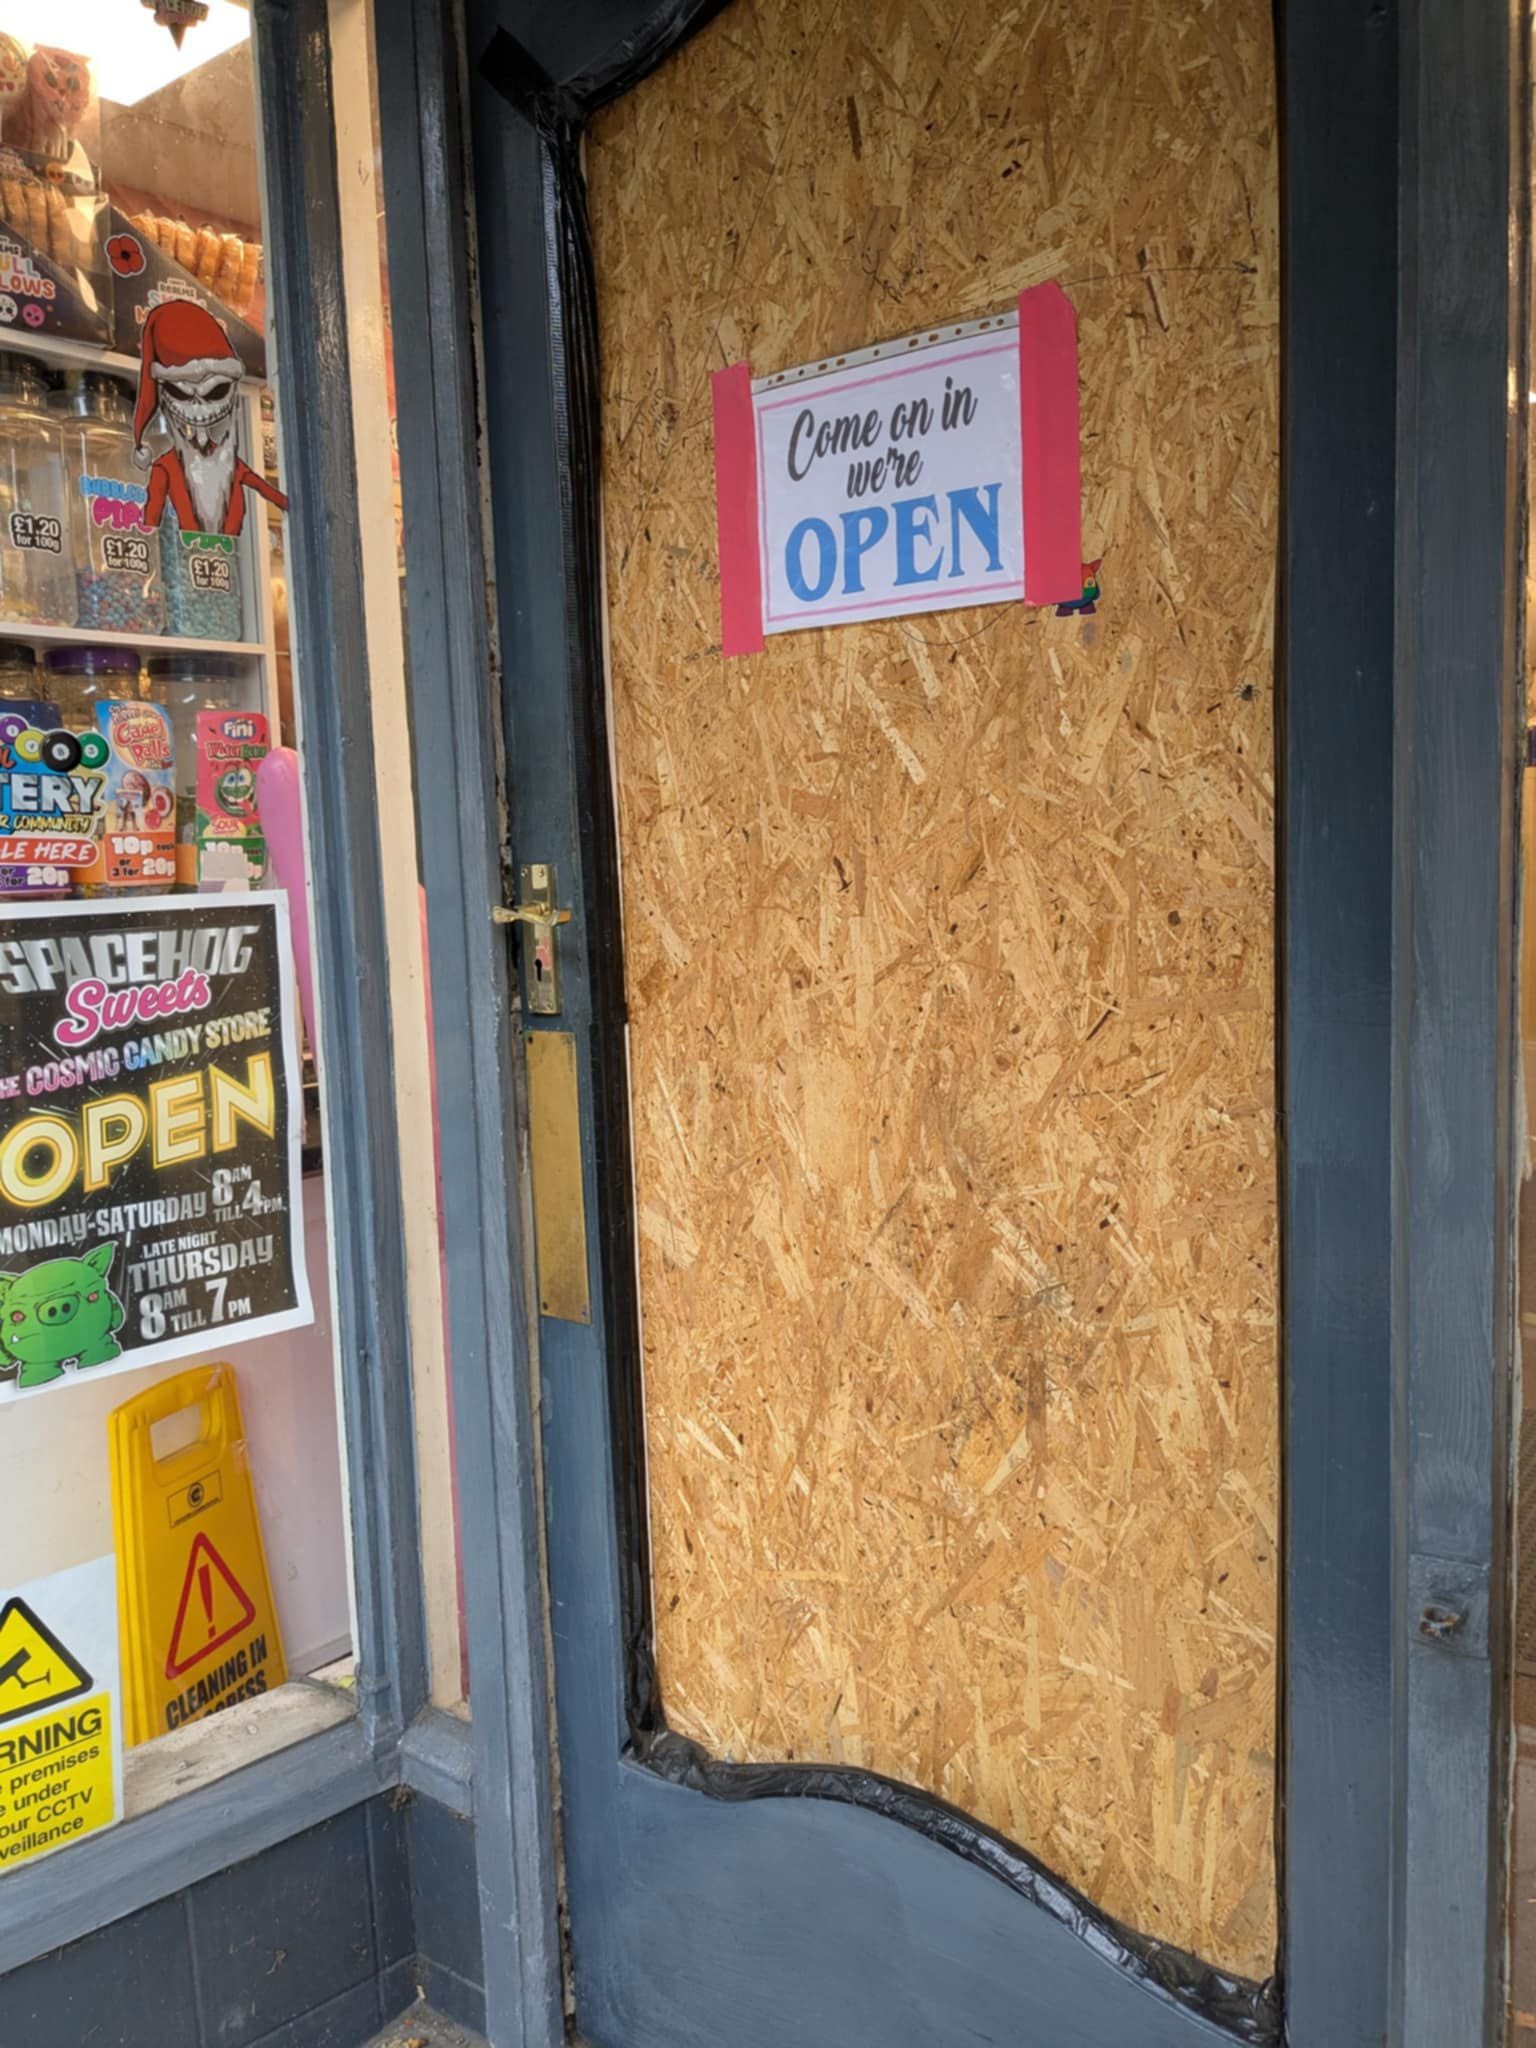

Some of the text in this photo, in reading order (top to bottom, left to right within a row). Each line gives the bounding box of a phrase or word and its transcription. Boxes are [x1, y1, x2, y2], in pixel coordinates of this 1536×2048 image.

[787, 376, 979, 482] Come on in
[846, 446, 925, 499] we're
[13, 516, 60, 538] £1.20
[17, 535, 32, 546] for
[785, 482, 1005, 603] OPEN
[105, 539, 148, 559] £1.20
[193, 560, 229, 579] £1.20
[223, 718, 255, 739] Fini
[14, 815, 91, 833] COMMUNITY
[34, 841, 94, 861] HERE
[111, 835, 154, 856] 10p
[26, 866, 70, 887] 20p
[142, 857, 175, 877] 20p
[0, 925, 260, 994] SPACEHOG
[55, 967, 211, 1047] Sweets
[26, 1046, 121, 1097] COSMIC
[123, 1023, 204, 1072] CANDY
[204, 1006, 272, 1050] STORE
[0, 1050, 275, 1208] OPEN
[213, 1205, 244, 1223] TILL
[142, 1230, 218, 1259] LATE NIGHT
[127, 1234, 274, 1294] THURSDAY
[170, 1309, 207, 1333] TILL
[165, 1632, 268, 1732] CLEANING IN
[0, 1707, 103, 1766] RNING
[10, 1745, 100, 1795] premises
[14, 1778, 71, 1812] under
[36, 1786, 94, 1824] CCTV
